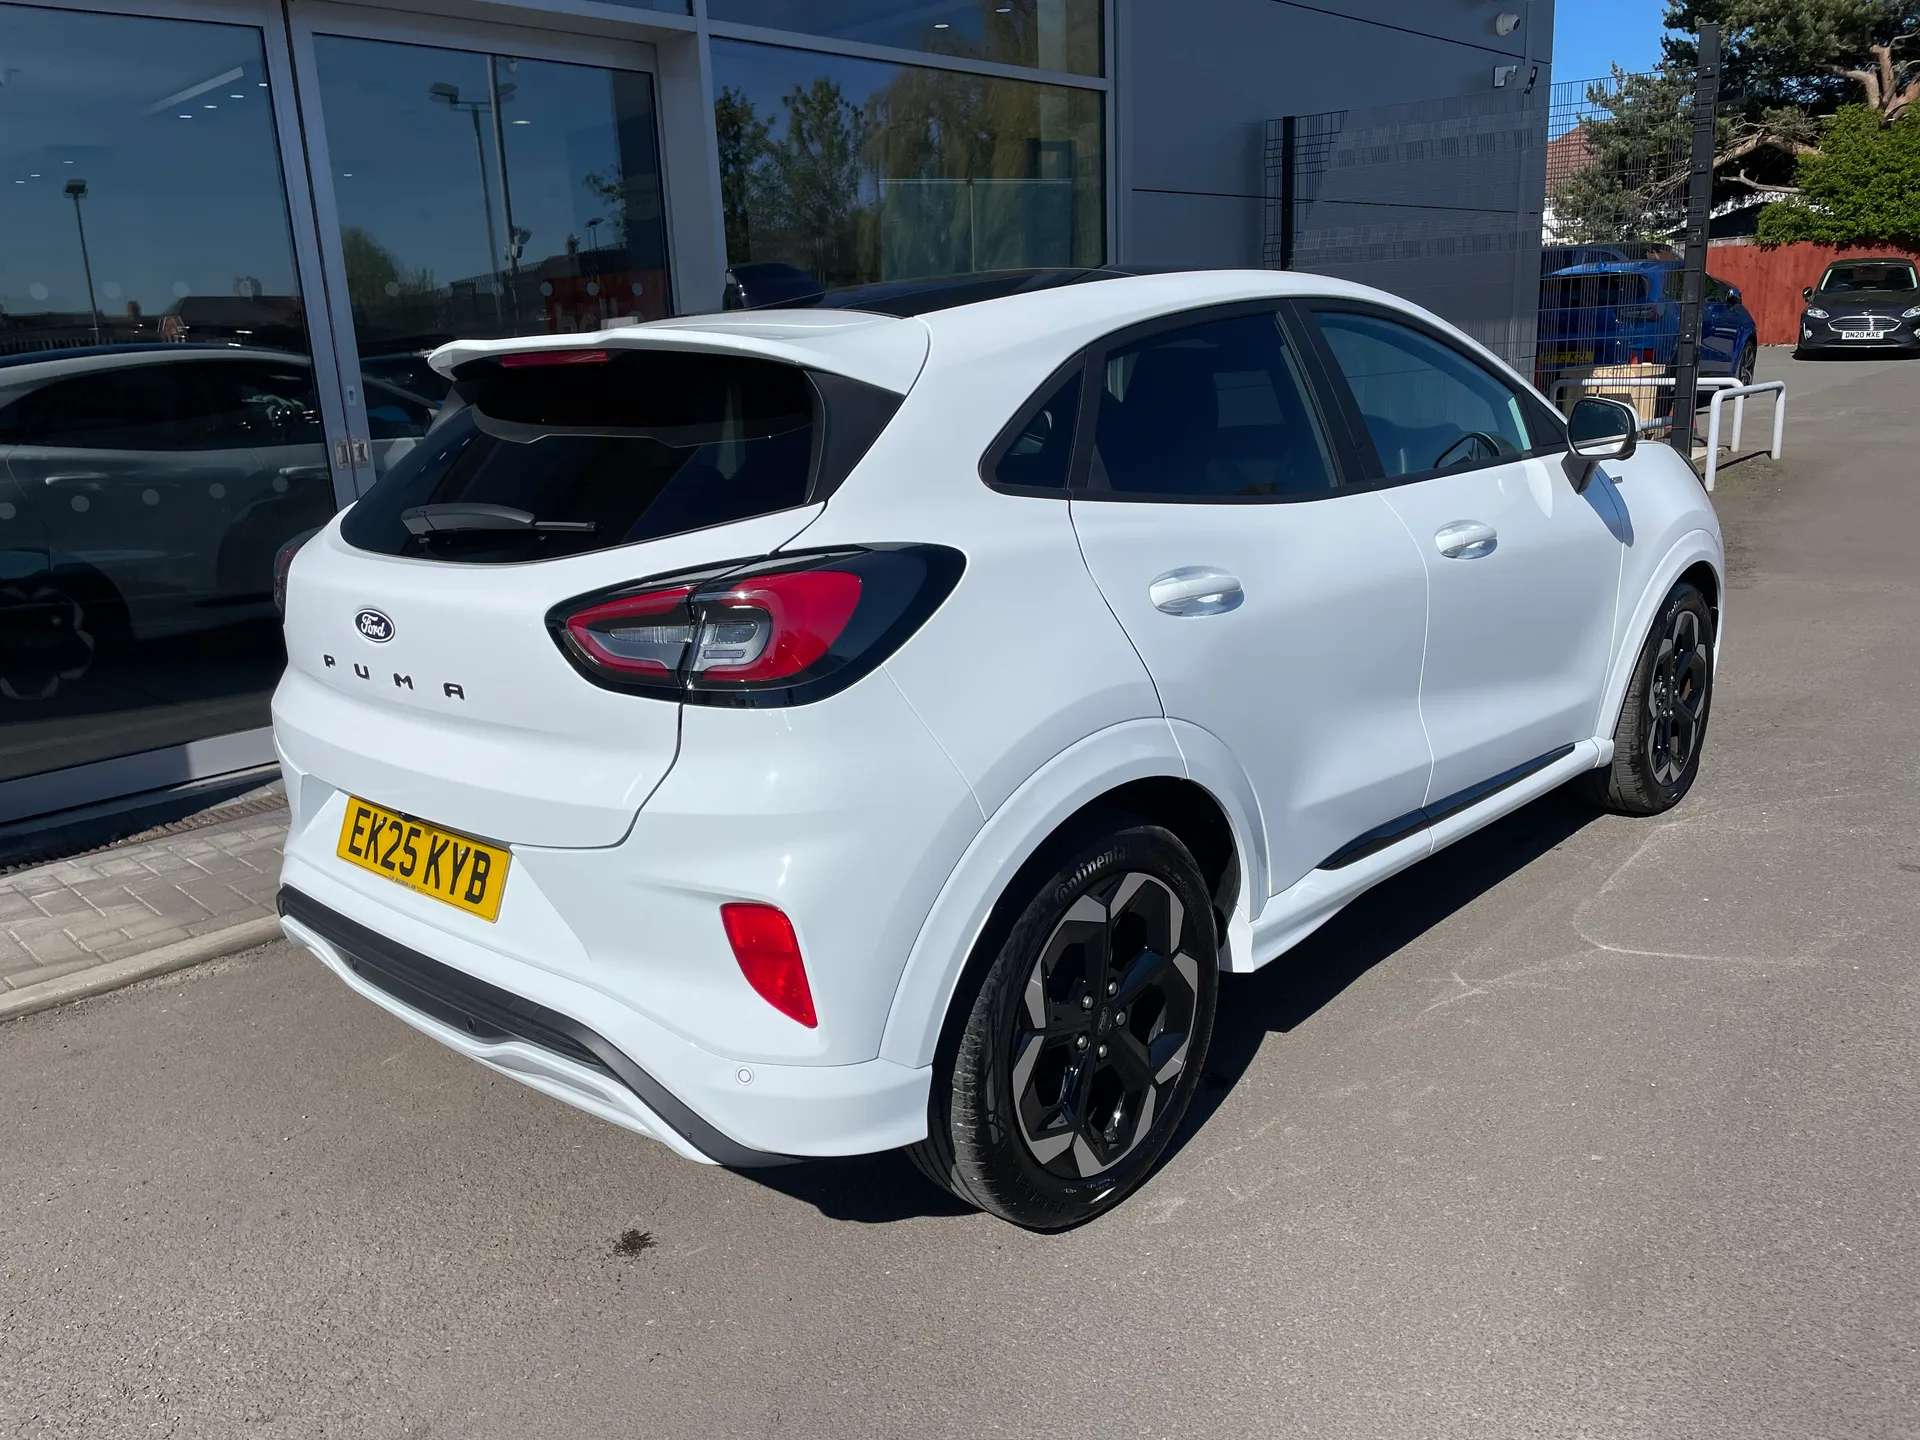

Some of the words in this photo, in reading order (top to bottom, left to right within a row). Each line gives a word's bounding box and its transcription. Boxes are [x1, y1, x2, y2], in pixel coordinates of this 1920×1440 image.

[360, 613, 386, 637] Ford
[323, 654, 465, 701] PUMA
[348, 806, 422, 878] EK25
[422, 834, 491, 905] KYB
